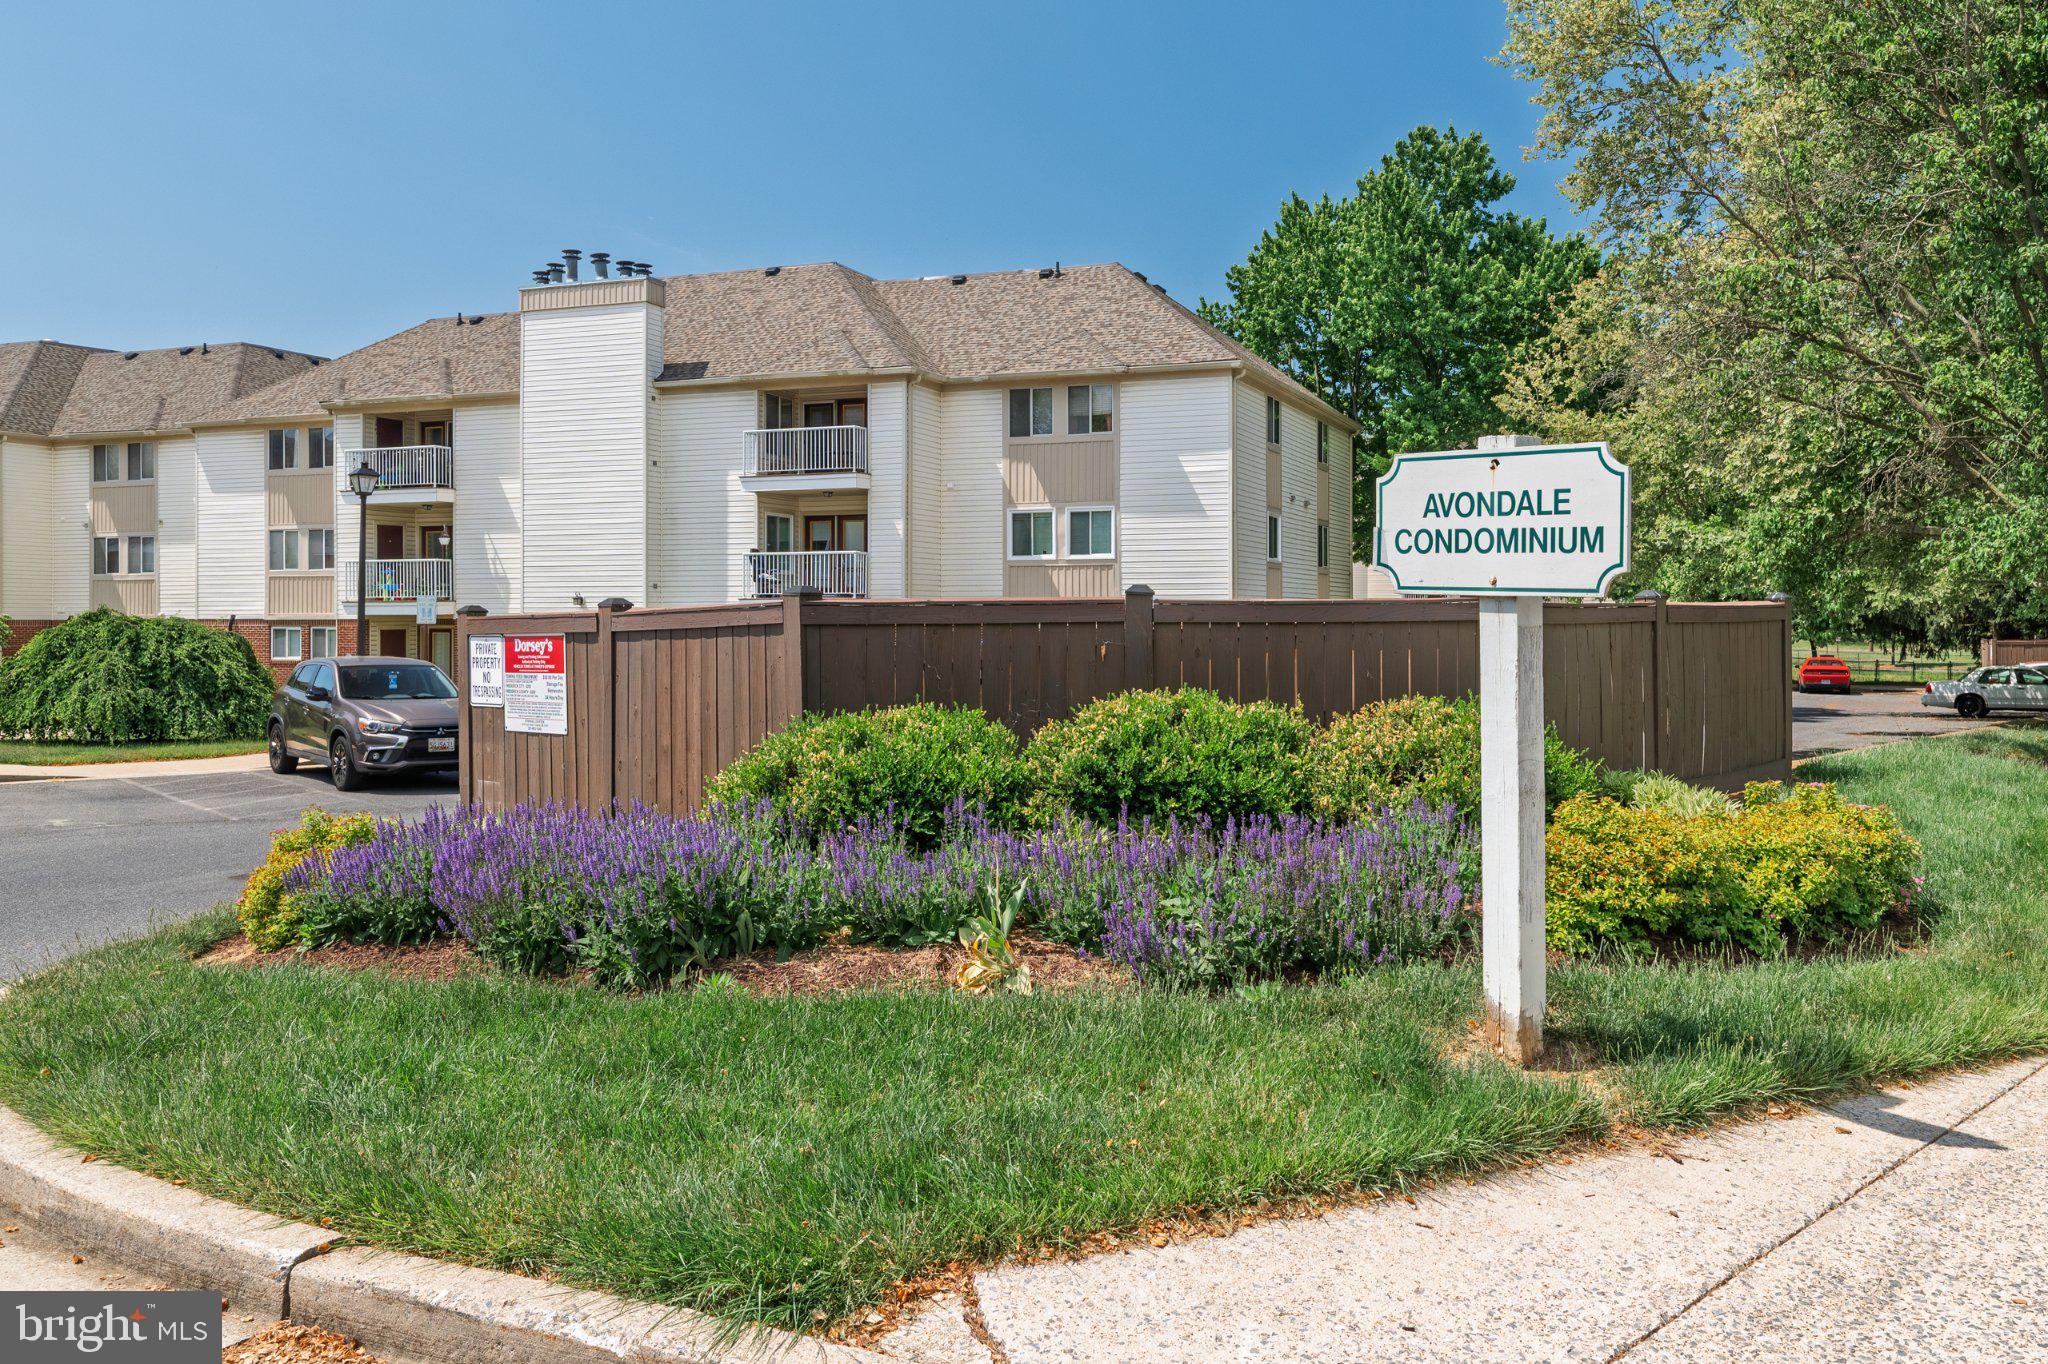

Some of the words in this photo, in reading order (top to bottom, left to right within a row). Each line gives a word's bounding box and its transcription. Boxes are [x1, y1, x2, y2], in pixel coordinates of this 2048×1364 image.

[1422, 488, 1572, 518] AVONDALE
[1395, 525, 1604, 554] CONDOMINIUM
[475, 643, 497, 655] PRIVATE
[514, 638, 553, 655] Dorsey's
[472, 657, 501, 669] PROPERTY
[482, 671, 491, 683] NO
[472, 685, 502, 699] TRESPASSING
